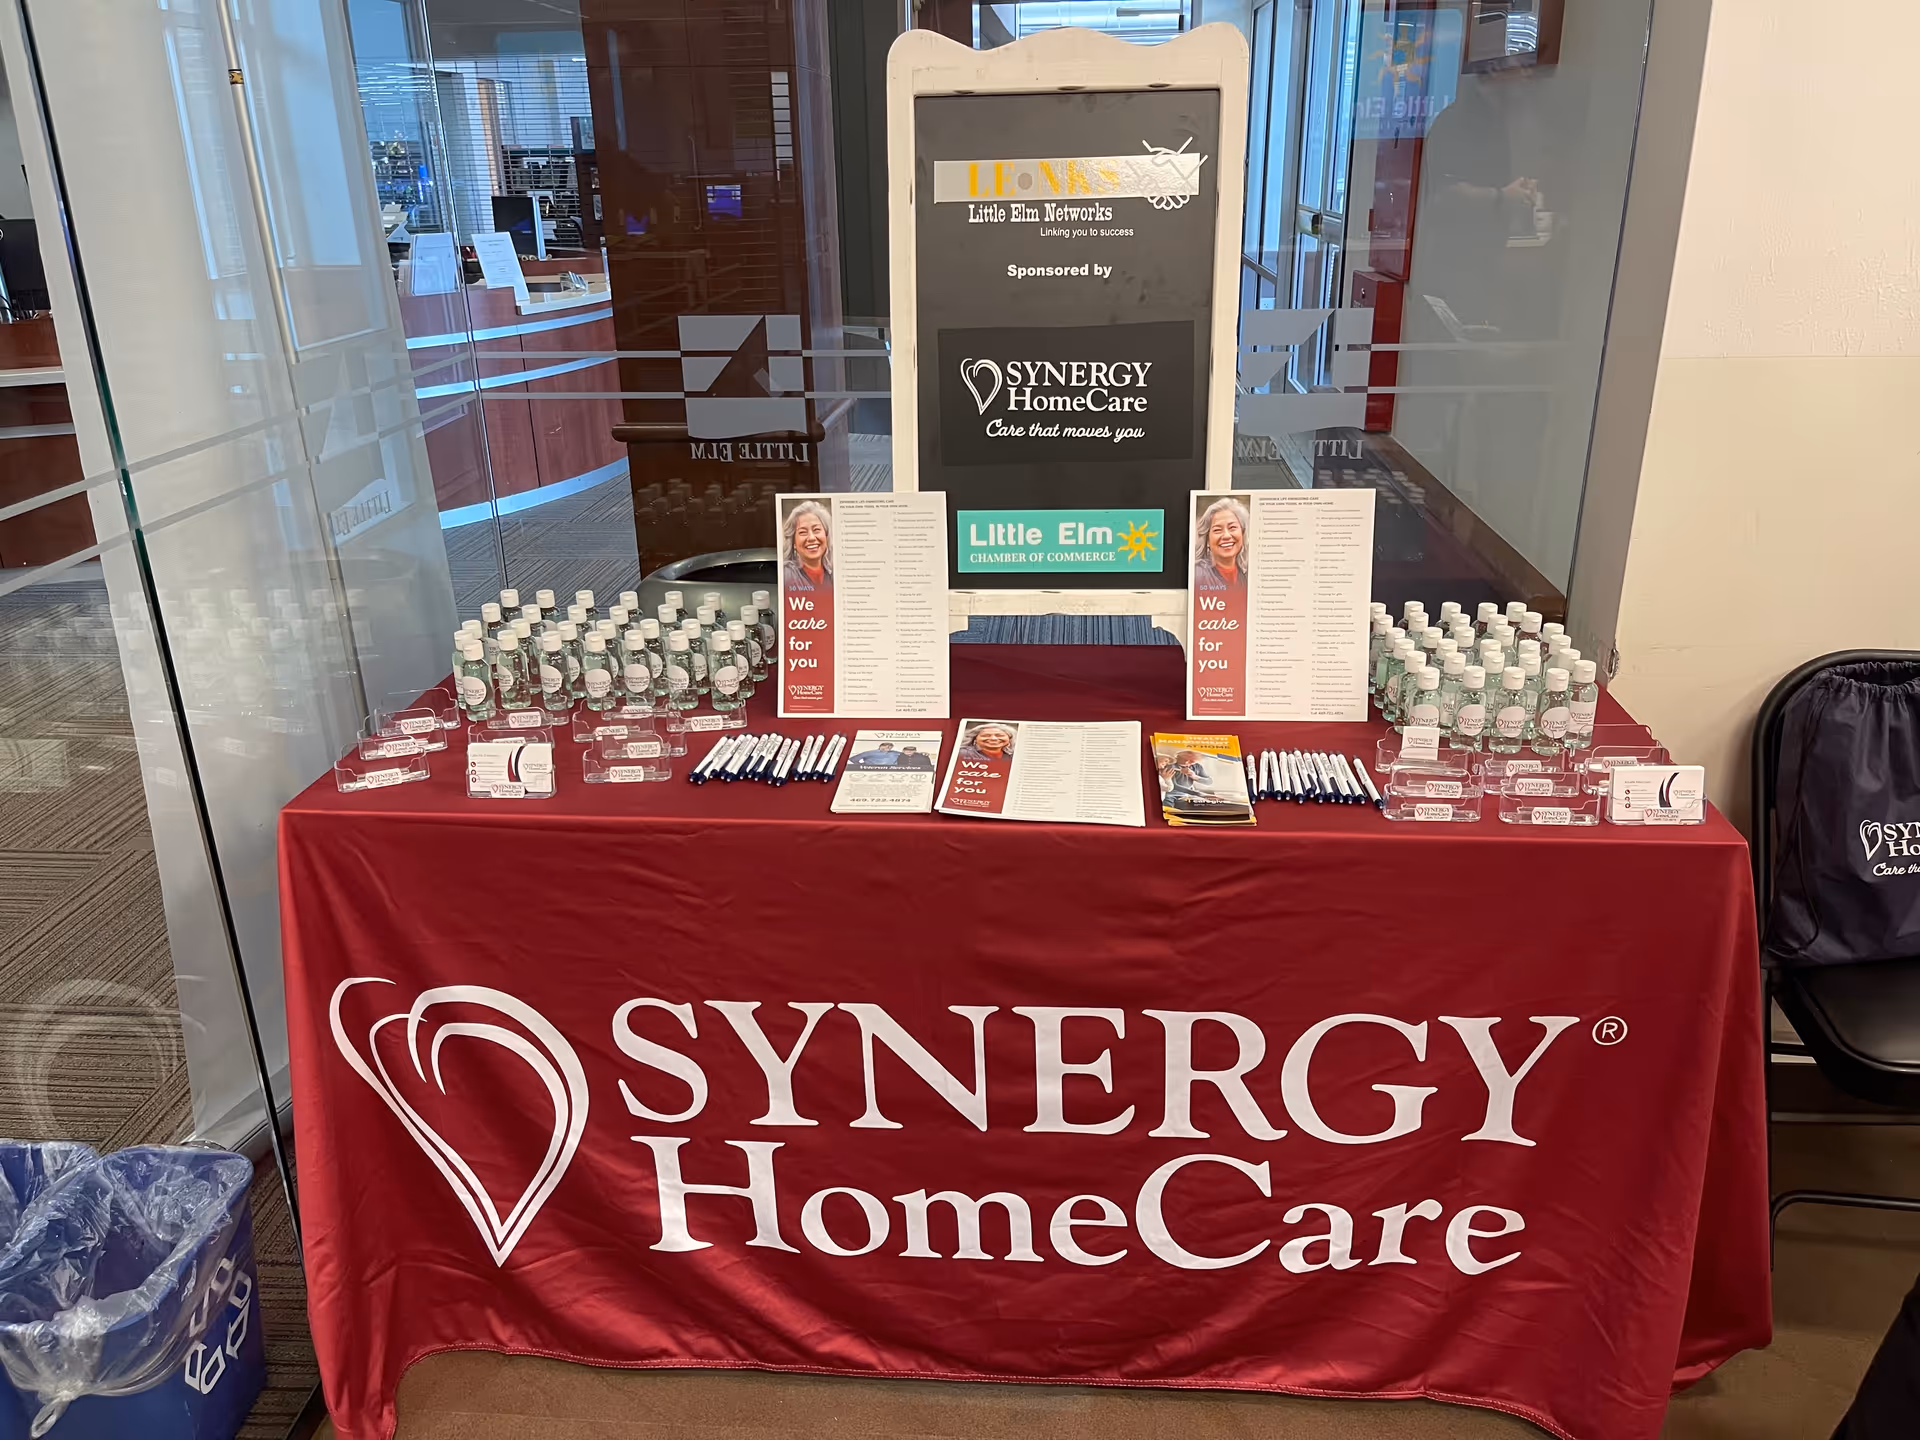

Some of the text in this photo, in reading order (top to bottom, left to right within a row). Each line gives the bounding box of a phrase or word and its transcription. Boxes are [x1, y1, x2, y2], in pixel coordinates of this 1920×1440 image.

[968, 202, 1113, 223] Little Elm Networks
[1040, 227, 1134, 239] Linking you to success
[1007, 264, 1113, 279] Sponsored by
[1006, 361, 1152, 387] SYNERGY
[1007, 387, 1148, 412] HomeCare
[986, 418, 1146, 443] Care that moves you
[1058, 522, 1113, 545] Elm
[970, 551, 1116, 563] CHAMBER OF COMMERCE
[788, 596, 814, 611] We
[1199, 596, 1227, 611] We
[788, 617, 828, 630] care
[1198, 617, 1240, 631] care
[789, 636, 813, 651] for
[1198, 636, 1224, 651] for
[789, 658, 818, 672] you
[1198, 659, 1229, 673] you
[961, 760, 989, 770] We
[956, 778, 983, 786] for
[954, 786, 987, 794] you
[1872, 862, 1906, 876] Care
[612, 997, 1580, 1147] SYNERGY
[630, 1135, 1526, 1275] HomeCare
